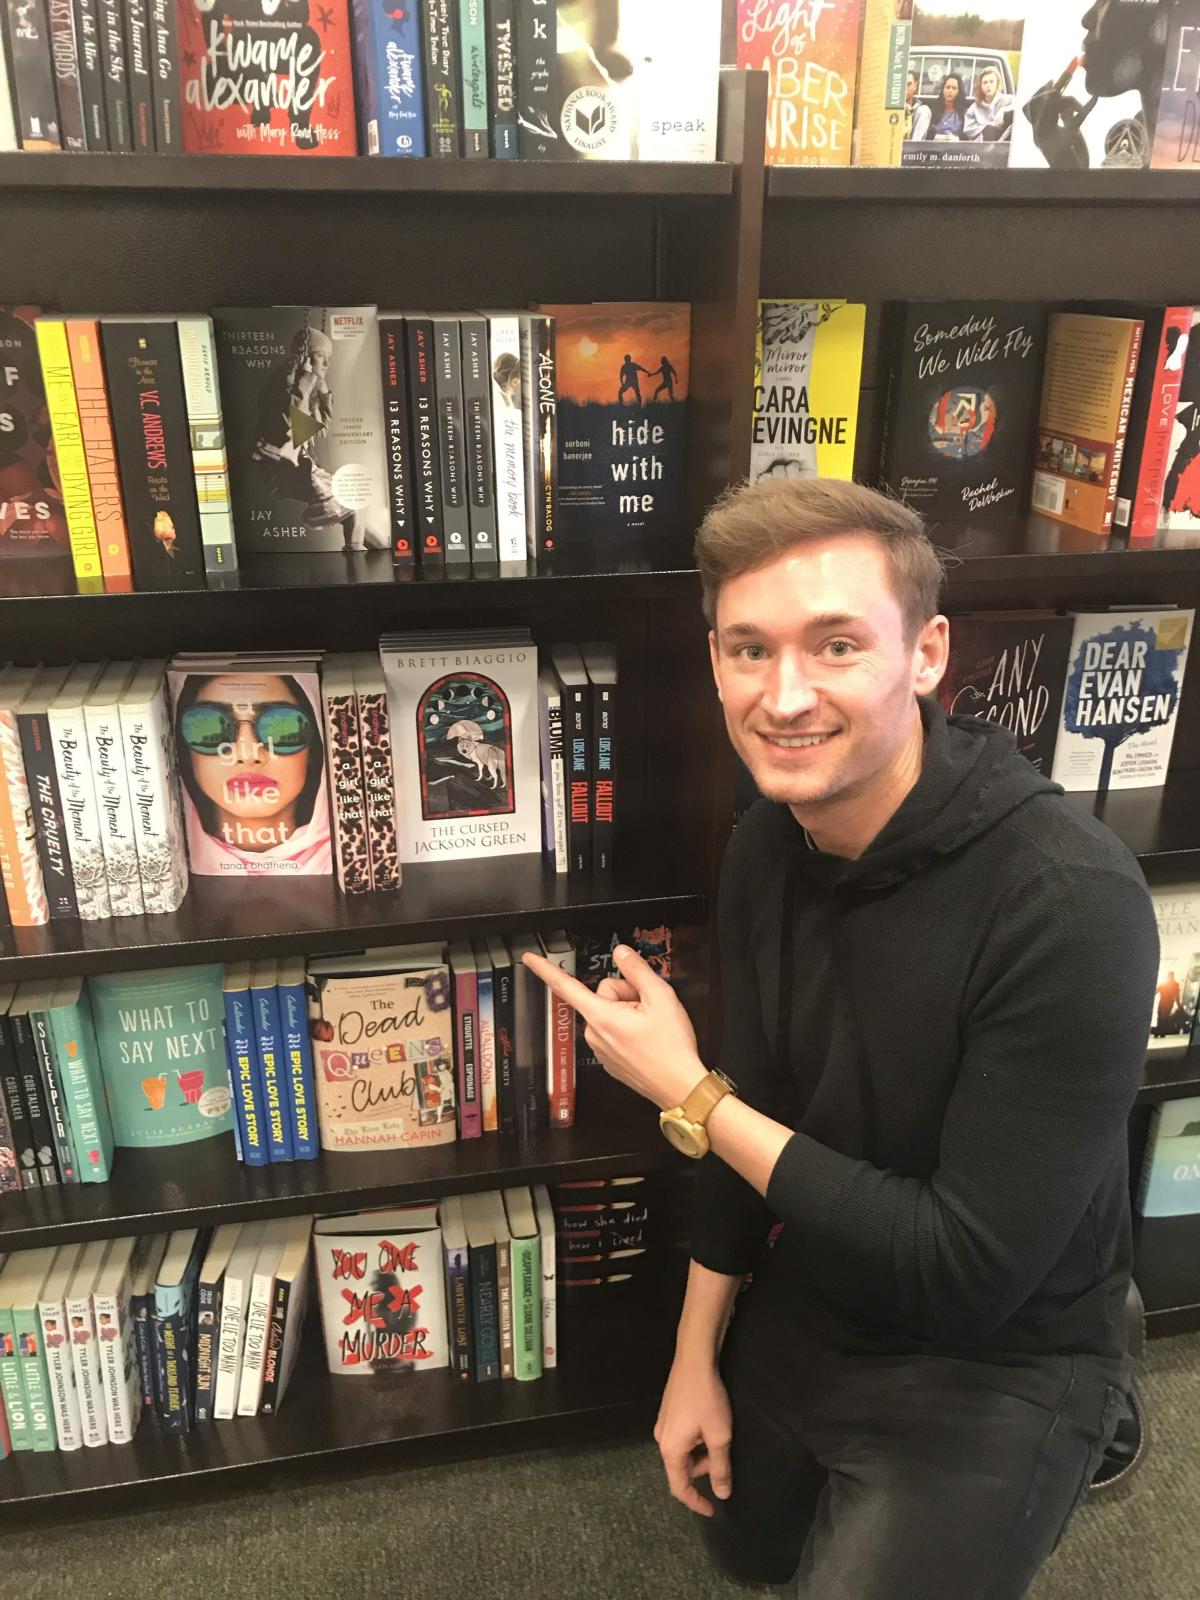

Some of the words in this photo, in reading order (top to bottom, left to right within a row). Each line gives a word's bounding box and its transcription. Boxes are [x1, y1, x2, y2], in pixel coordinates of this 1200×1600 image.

[107, 11, 116, 25] in
[742, 0, 836, 56] Light
[109, 30, 121, 52] the
[207, 20, 327, 77] kwame
[441, 26, 450, 47] True
[790, 32, 807, 55] of
[108, 56, 124, 82] Sky
[442, 50, 450, 76] Diary
[497, 19, 514, 112] TWISTED
[185, 56, 336, 115] alexander
[564, 91, 584, 132] NATIONAL
[586, 90, 607, 102] BOOK
[605, 101, 618, 133] AWARD
[236, 126, 257, 139] with
[260, 123, 287, 146] Mary
[290, 123, 313, 143] Rand
[313, 124, 340, 144] Hess
[651, 119, 706, 135] speak
[574, 137, 607, 150] FINALIST
[903, 152, 927, 163] emily
[942, 152, 980, 162] danforth
[334, 316, 364, 326] NETFLIX
[914, 315, 996, 352] Someday
[387, 333, 395, 350] JAY
[766, 347, 809, 361] Mirror
[918, 350, 950, 379] We
[955, 338, 999, 369] Will
[1003, 326, 1033, 358] Fly
[245, 359, 272, 368] WHY
[388, 355, 397, 386] ASHER
[539, 353, 556, 415] ALONE
[78, 387, 110, 425] THE
[139, 390, 160, 408] V.C.
[389, 401, 399, 412] 13
[419, 397, 428, 409] 13
[753, 385, 809, 413] CARA
[1117, 377, 1135, 434] MEXICAN
[504, 418, 520, 437] the
[612, 419, 664, 445] hide
[752, 417, 848, 444] EVINGNE
[143, 412, 168, 470] ANDREWS
[390, 419, 403, 480] REASONS
[420, 416, 432, 477] REASONS
[565, 439, 590, 448] sorboni
[503, 442, 517, 487] memory
[563, 452, 592, 461] banerjee
[611, 456, 664, 481] with
[1108, 437, 1124, 501] WHITEBOY
[85, 439, 123, 522] HATERS
[961, 478, 998, 500] Rachel
[62, 472, 92, 521] DYING
[395, 485, 406, 515] WHY
[424, 481, 435, 512] WHY
[507, 493, 524, 518] book
[620, 494, 654, 513] me
[250, 510, 272, 521] JAY
[71, 526, 98, 560] GIRL
[262, 526, 307, 537] ASHER
[397, 657, 448, 669] BRETT
[455, 653, 528, 666] BIAGGIO
[987, 633, 1045, 702] ANY
[1084, 640, 1148, 671] DEAR
[1079, 669, 1142, 699] EVAN
[1075, 694, 1171, 727] HANSEN
[62, 728, 73, 739] The
[549, 706, 563, 760] BLUME
[59, 739, 81, 781] Beauty
[217, 736, 278, 767] girl
[36, 774, 51, 805] THE
[223, 780, 280, 805] like
[338, 777, 359, 789] girl
[369, 776, 390, 788] girl
[339, 795, 361, 805] like
[370, 793, 391, 803] like
[571, 782, 588, 823] FALLOUT
[595, 781, 613, 822] FALLOUT
[66, 798, 92, 844] Moment
[340, 809, 364, 820] that
[371, 808, 394, 818] that
[41, 807, 65, 876] CRUELTY
[223, 821, 289, 845] that
[430, 827, 455, 838] THE
[460, 821, 510, 837] CURSED
[415, 838, 477, 855] JACKSON
[481, 833, 527, 847] GREEN
[220, 861, 248, 871] tanaz
[250, 861, 299, 871] bhathena
[118, 1005, 174, 1033] WHAT
[185, 999, 210, 1023] TO
[370, 999, 394, 1010] The
[339, 995, 424, 1045] Dead
[464, 1015, 472, 1051] ETIQUETTE
[557, 1002, 569, 1042] LOVED
[119, 1041, 153, 1064] SAY
[166, 1027, 216, 1060] NEXT
[67, 1058, 83, 1085] WHAT
[238, 1056, 250, 1082] EPIC
[264, 1053, 275, 1079] EPIC
[290, 1051, 302, 1076] EPIC
[24, 1074, 34, 1094] CODE
[37, 1021, 66, 1139] SLEEPER
[351, 1070, 415, 1112] Club
[466, 1063, 474, 1100] ESPIONAGE
[74, 1087, 88, 1100] TO
[241, 1083, 255, 1117] LOVE
[267, 1080, 280, 1113] LOVE
[293, 1077, 305, 1110] LOVE
[28, 1095, 40, 1119] TALKER
[77, 1100, 92, 1122] SAY
[80, 1122, 99, 1145] NEXT
[246, 1116, 259, 1147] STORY
[270, 1112, 284, 1144] STORY
[296, 1110, 309, 1141] STORY
[335, 1134, 396, 1145] HANNAH
[400, 1129, 442, 1141] CAPIN
[564, 1217, 587, 1228] how
[595, 1215, 616, 1227] she
[623, 1208, 648, 1224] died
[331, 1248, 367, 1280] YOU
[379, 1245, 421, 1272] OWE
[350, 1291, 380, 1321] ME
[400, 1289, 412, 1318] A
[455, 1276, 465, 1325] LABYRINTH
[224, 1305, 240, 1323] ONE
[223, 1322, 239, 1336] LIE
[457, 1326, 467, 1346] LOST
[198, 1333, 212, 1367] MIDNIGHT
[221, 1337, 237, 1353] TOO
[342, 1329, 427, 1362] MURDER
[52, 1351, 61, 1371] TYLER
[218, 1354, 236, 1374] MANY
[54, 1371, 66, 1403] JOHNSON
[198, 1367, 210, 1390] SUN
[2, 1361, 16, 1389] LITTLE
[9, 1401, 27, 1431] LION
[59, 1403, 69, 1418] WAS
[62, 1418, 71, 1434] HERE
